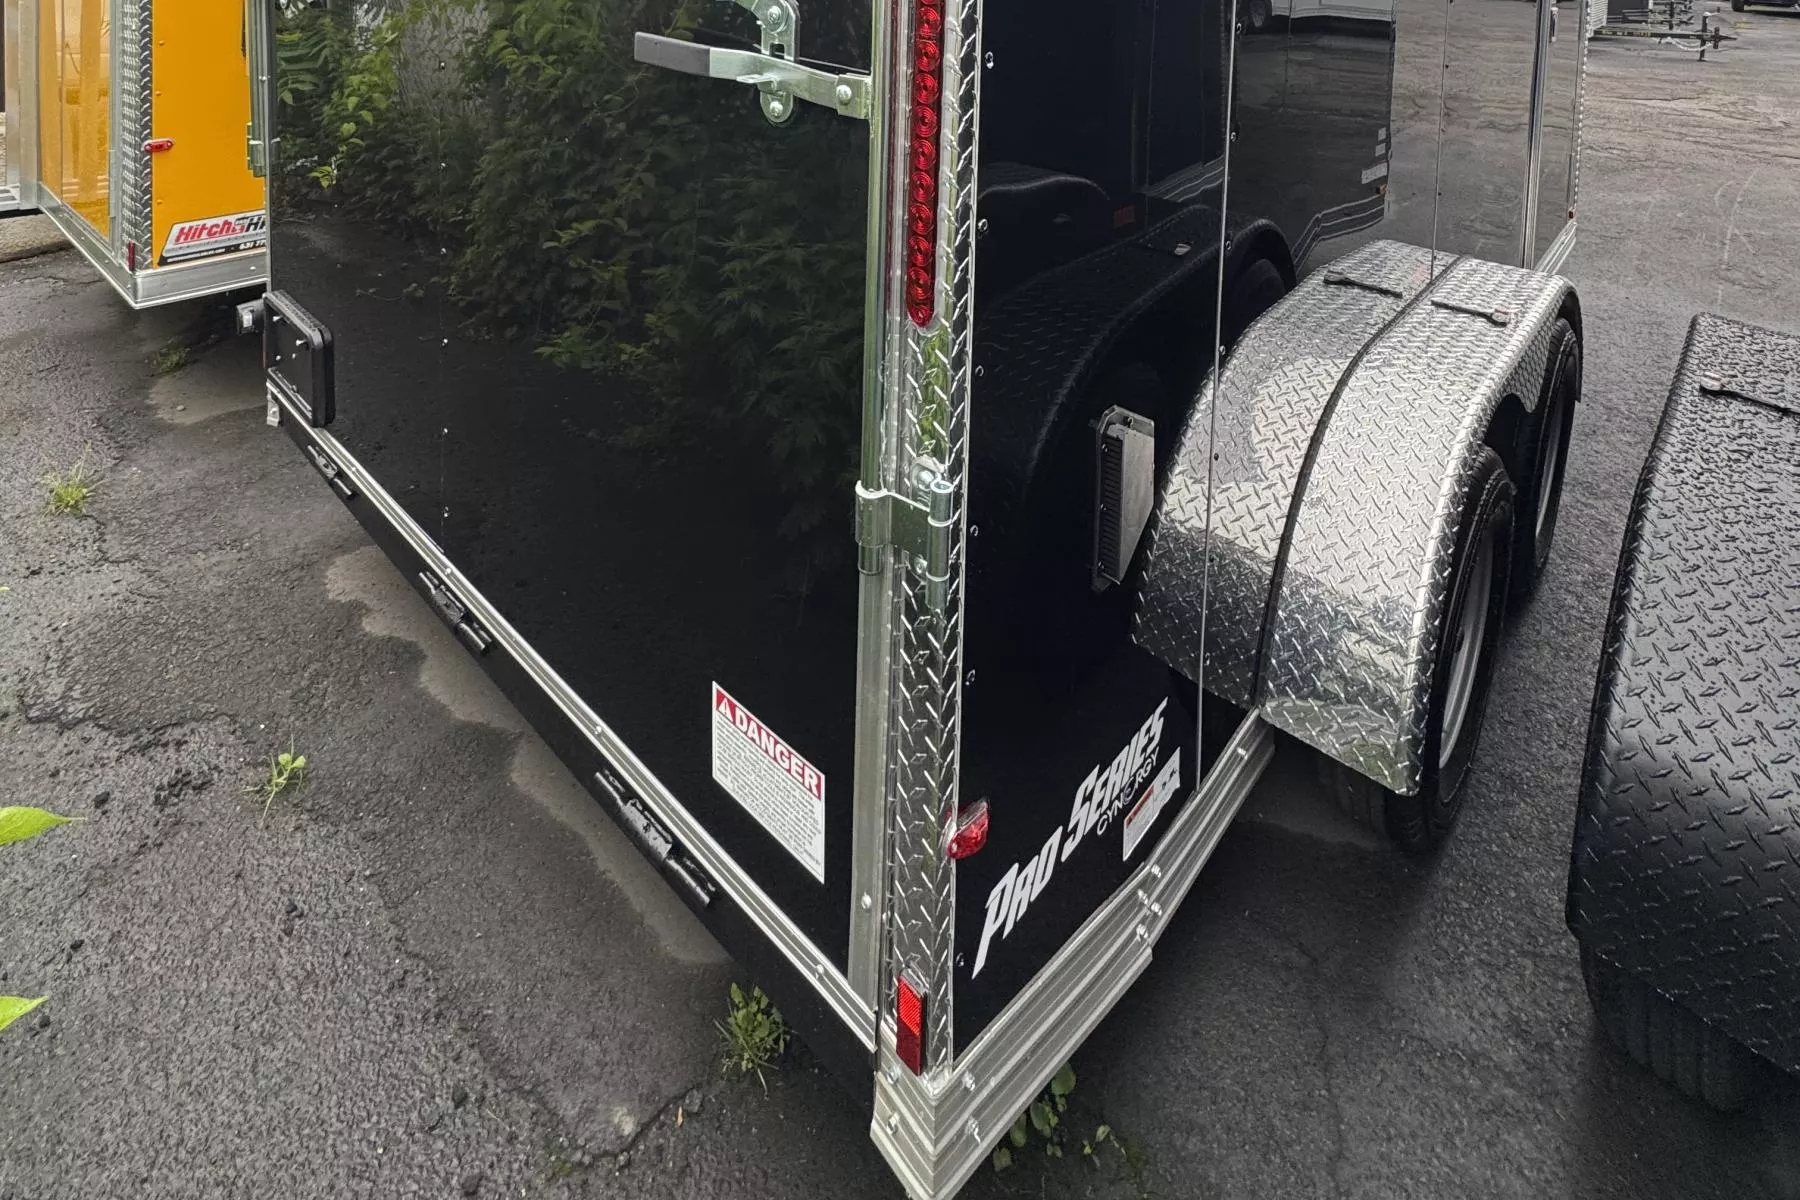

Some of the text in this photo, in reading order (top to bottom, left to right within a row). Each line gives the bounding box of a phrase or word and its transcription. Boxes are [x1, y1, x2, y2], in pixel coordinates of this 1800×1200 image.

[735, 706, 819, 797] DANGER
[971, 825, 1064, 980] PRO
[1061, 696, 1168, 863] SERIES
